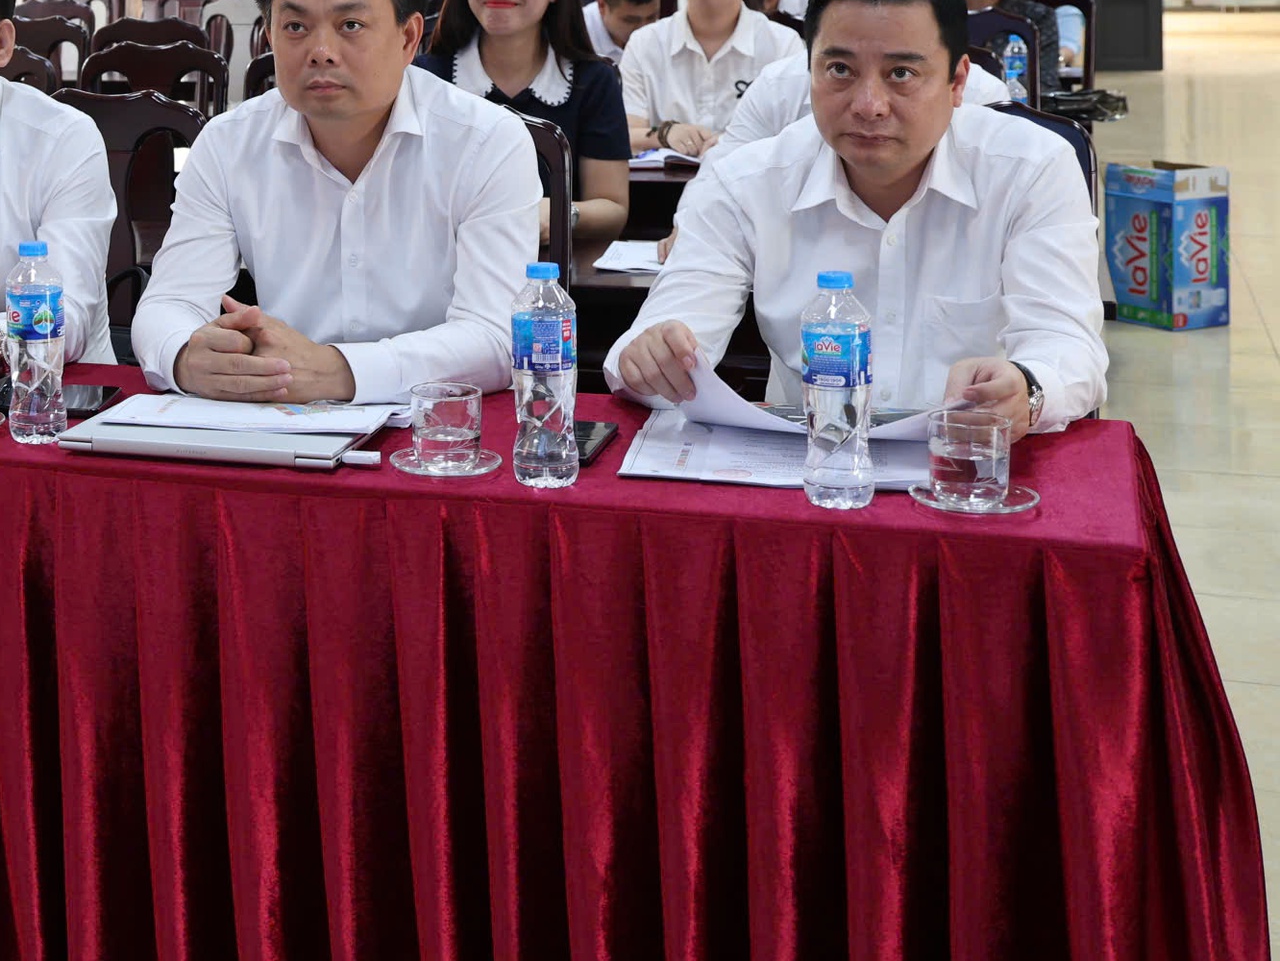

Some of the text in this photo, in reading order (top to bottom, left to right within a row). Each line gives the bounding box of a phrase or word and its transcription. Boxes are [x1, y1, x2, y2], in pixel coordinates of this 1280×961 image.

[1124, 213, 1149, 296] laVie
[1189, 209, 1209, 284] laVie
[814, 341, 841, 352] laVie
